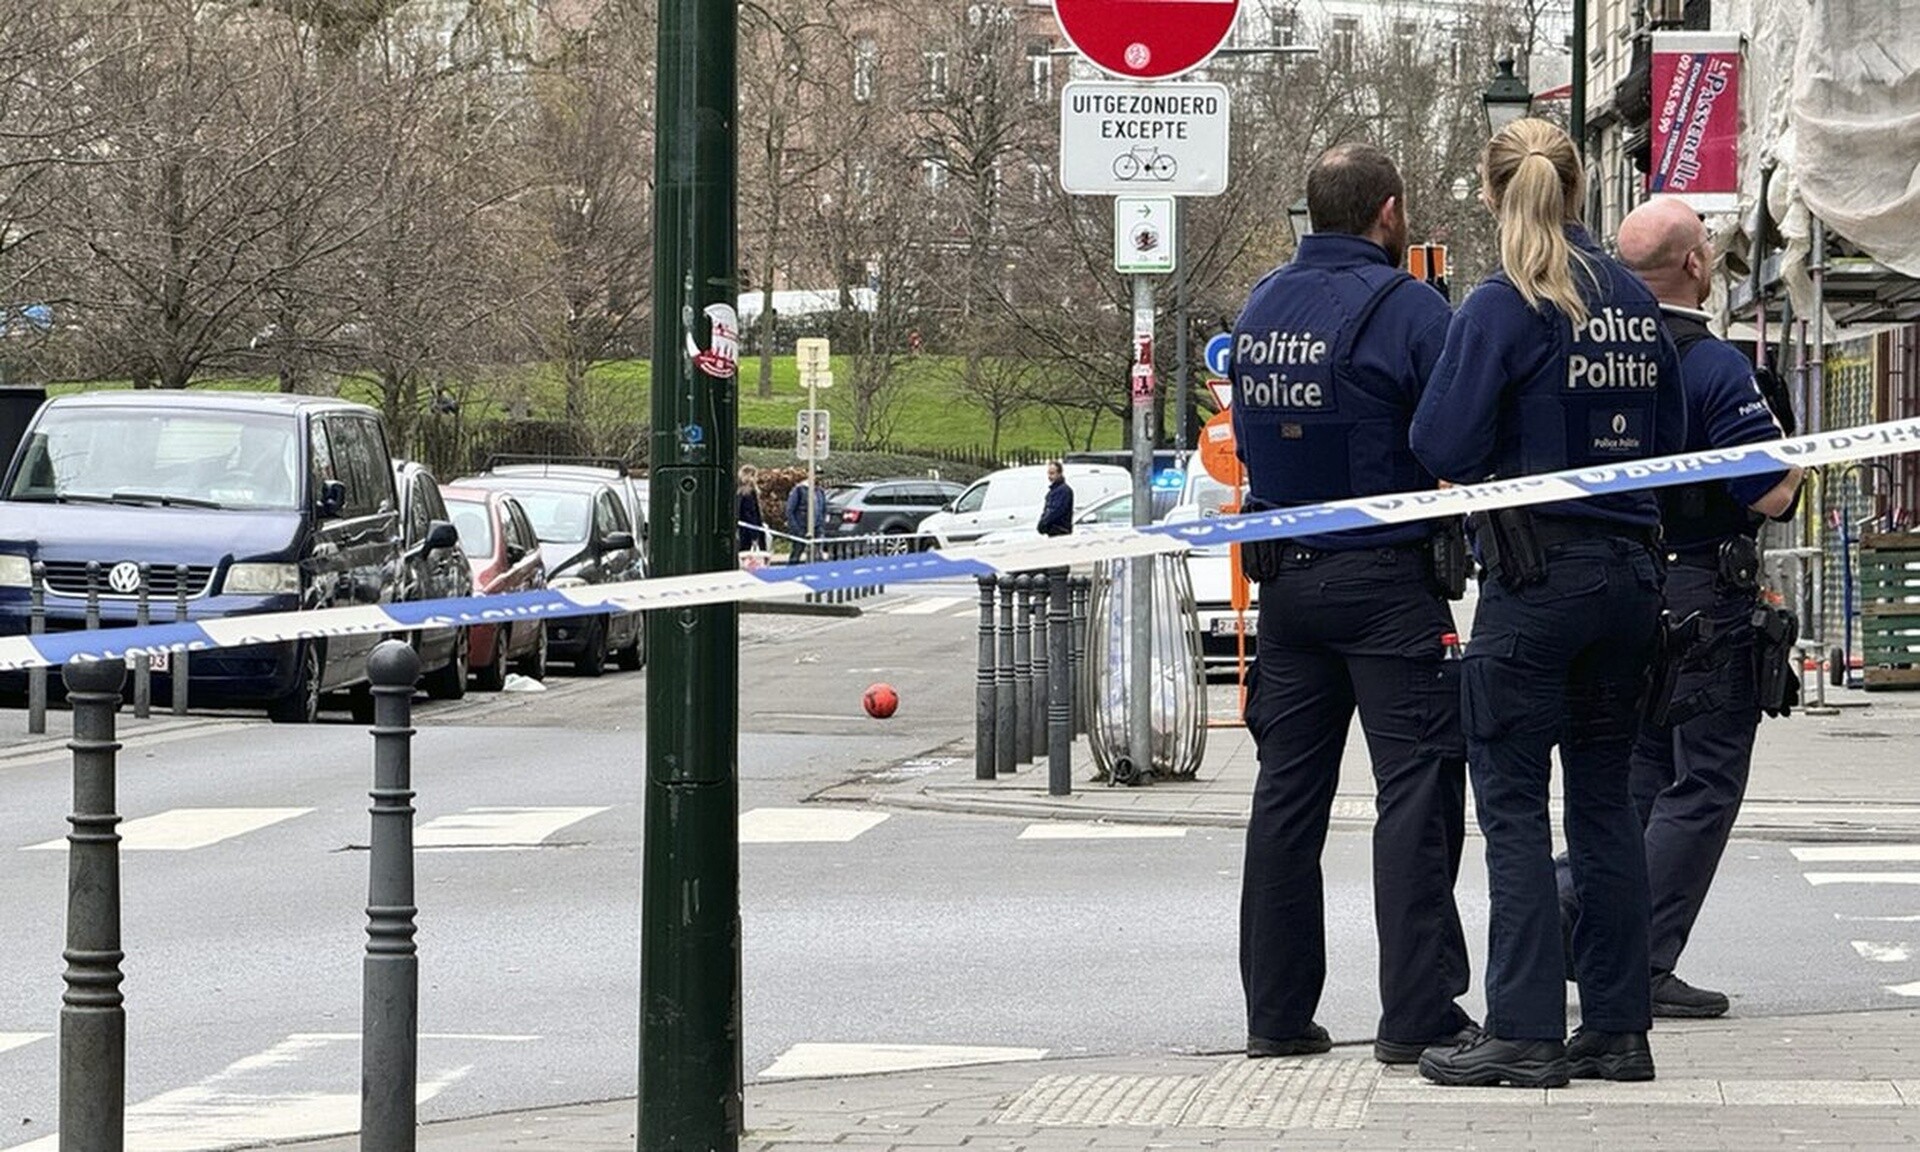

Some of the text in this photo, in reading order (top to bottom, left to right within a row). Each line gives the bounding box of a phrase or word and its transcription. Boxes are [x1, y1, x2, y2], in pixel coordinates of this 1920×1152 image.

[1073, 94, 1218, 116] UITGEZONDERD
[1101, 120, 1188, 140] EXCEPTE
[1572, 306, 1657, 343] Police
[1237, 331, 1326, 365] Politie
[1567, 351, 1659, 388] Politie
[1241, 373, 1323, 407] Police
